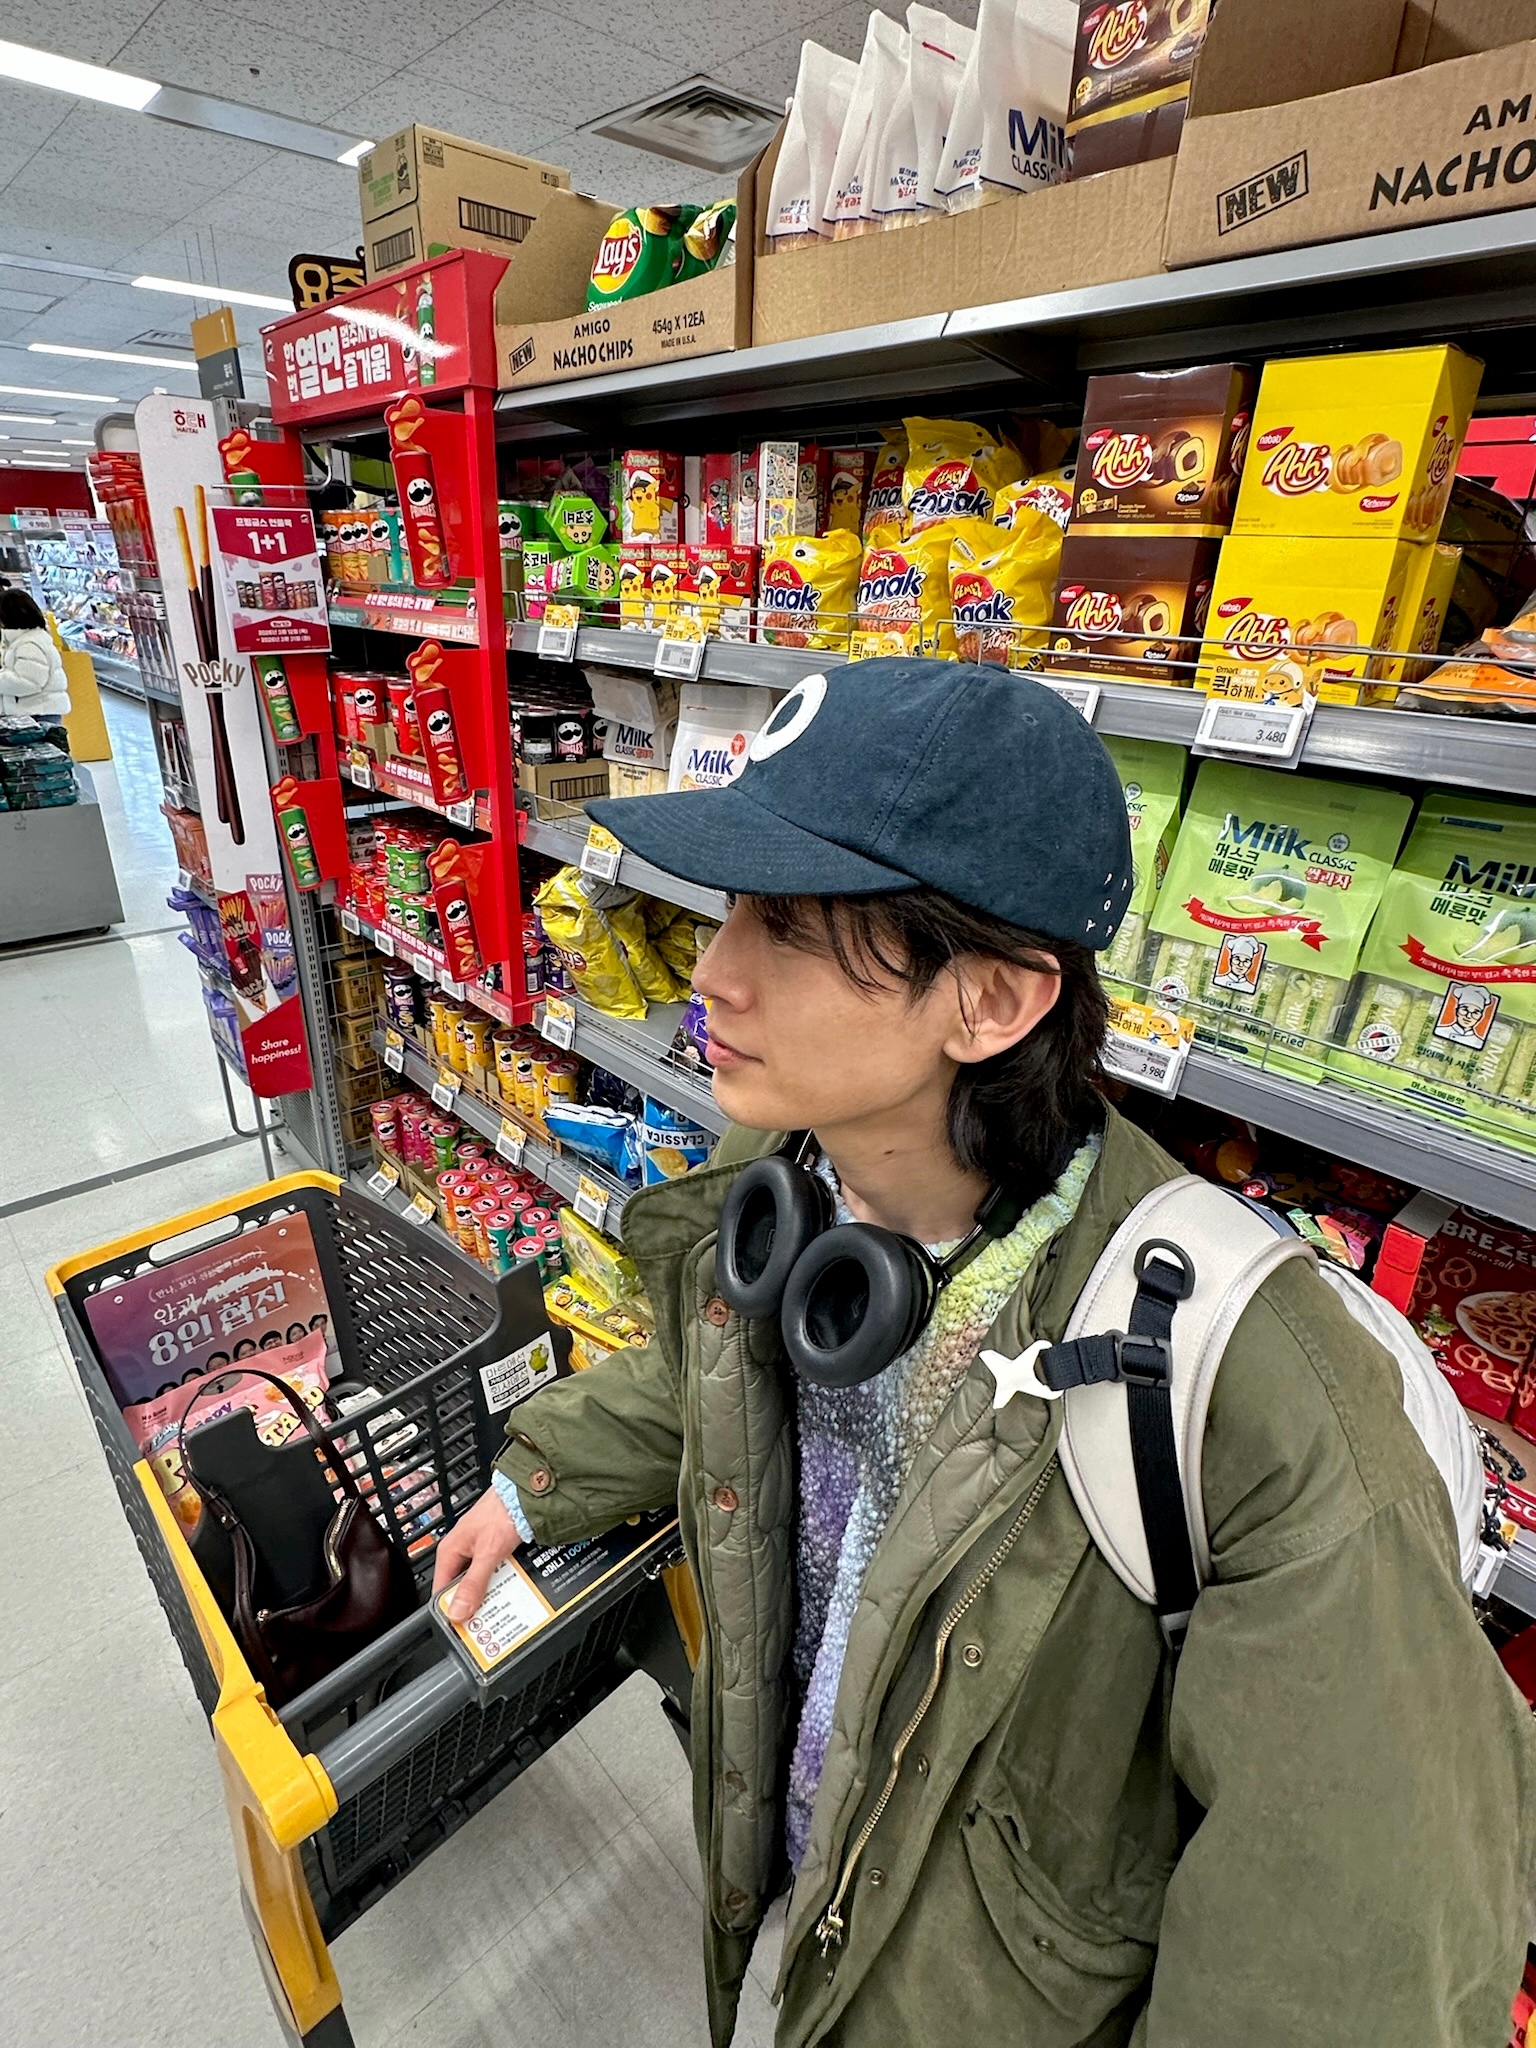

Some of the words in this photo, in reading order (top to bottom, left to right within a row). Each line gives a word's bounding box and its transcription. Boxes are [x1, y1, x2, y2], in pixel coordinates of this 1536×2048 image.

[1463, 94, 1536, 136] AM
[1008, 108, 1067, 168] Mil
[1369, 139, 1536, 211] NACHO
[1226, 160, 1300, 226] NEW
[594, 232, 640, 278] Lay's
[574, 319, 611, 339] AMIGO
[652, 317, 672, 336] 454g
[683, 310, 705, 328] 12EA
[342, 343, 392, 389] 즐거움!
[512, 343, 534, 370] NEW
[553, 344, 595, 371] NACHO
[599, 339, 634, 363] CHIPS
[1092, 433, 1149, 481] Ahh'
[1262, 443, 1330, 487] Ahh'
[247, 531, 287, 555] 1+1
[859, 566, 925, 604] naak
[953, 591, 1014, 629] naak
[1067, 592, 1120, 631] Ahh'
[182, 658, 246, 687] Pocky
[1216, 666, 1239, 675] emart
[1213, 676, 1231, 696] 퀵
[616, 724, 653, 749] Milk
[1256, 729, 1287, 744] 3,480
[615, 745, 636, 756] CLASSIC
[687, 749, 735, 776] Milk
[695, 773, 723, 786] CLASSIC
[1220, 814, 1312, 860] Milk
[1215, 843, 1260, 866] 머스크
[1309, 852, 1357, 871] CLASSIC
[1208, 858, 1254, 881] 메론맛
[1305, 866, 1352, 890] 쌀과자
[250, 875, 283, 892] Pocky
[1430, 896, 1487, 926] 메론맛
[252, 1044, 301, 1064] happiness!
[261, 1039, 289, 1051] Share
[1141, 1064, 1165, 1079] 3,980
[647, 1129, 705, 1146] CLASSICA
[149, 1313, 215, 1366] 8인
[563, 1539, 590, 1561] 100%
